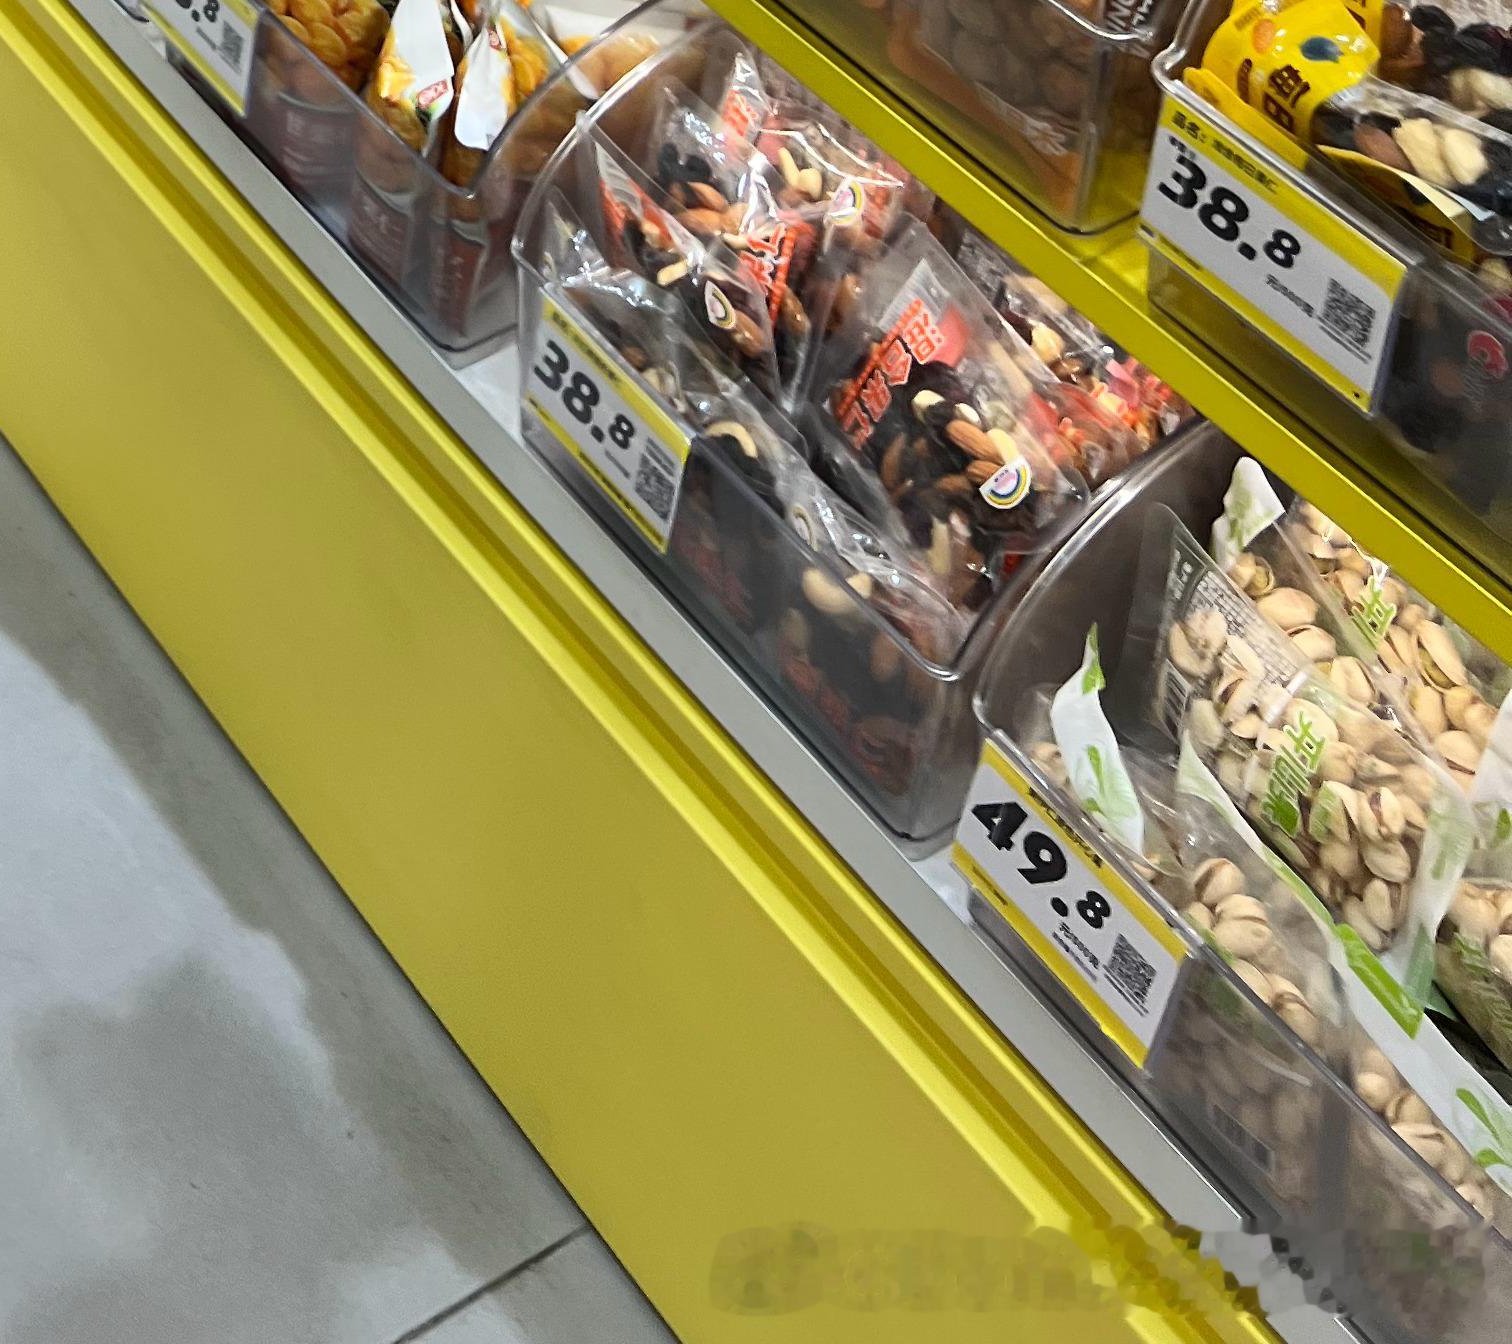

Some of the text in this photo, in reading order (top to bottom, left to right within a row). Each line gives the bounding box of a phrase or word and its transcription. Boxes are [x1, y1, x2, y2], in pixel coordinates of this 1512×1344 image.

[1157, 154, 1301, 269] 38.8
[534, 339, 635, 450] 38.8
[971, 800, 1112, 929] 49.8
